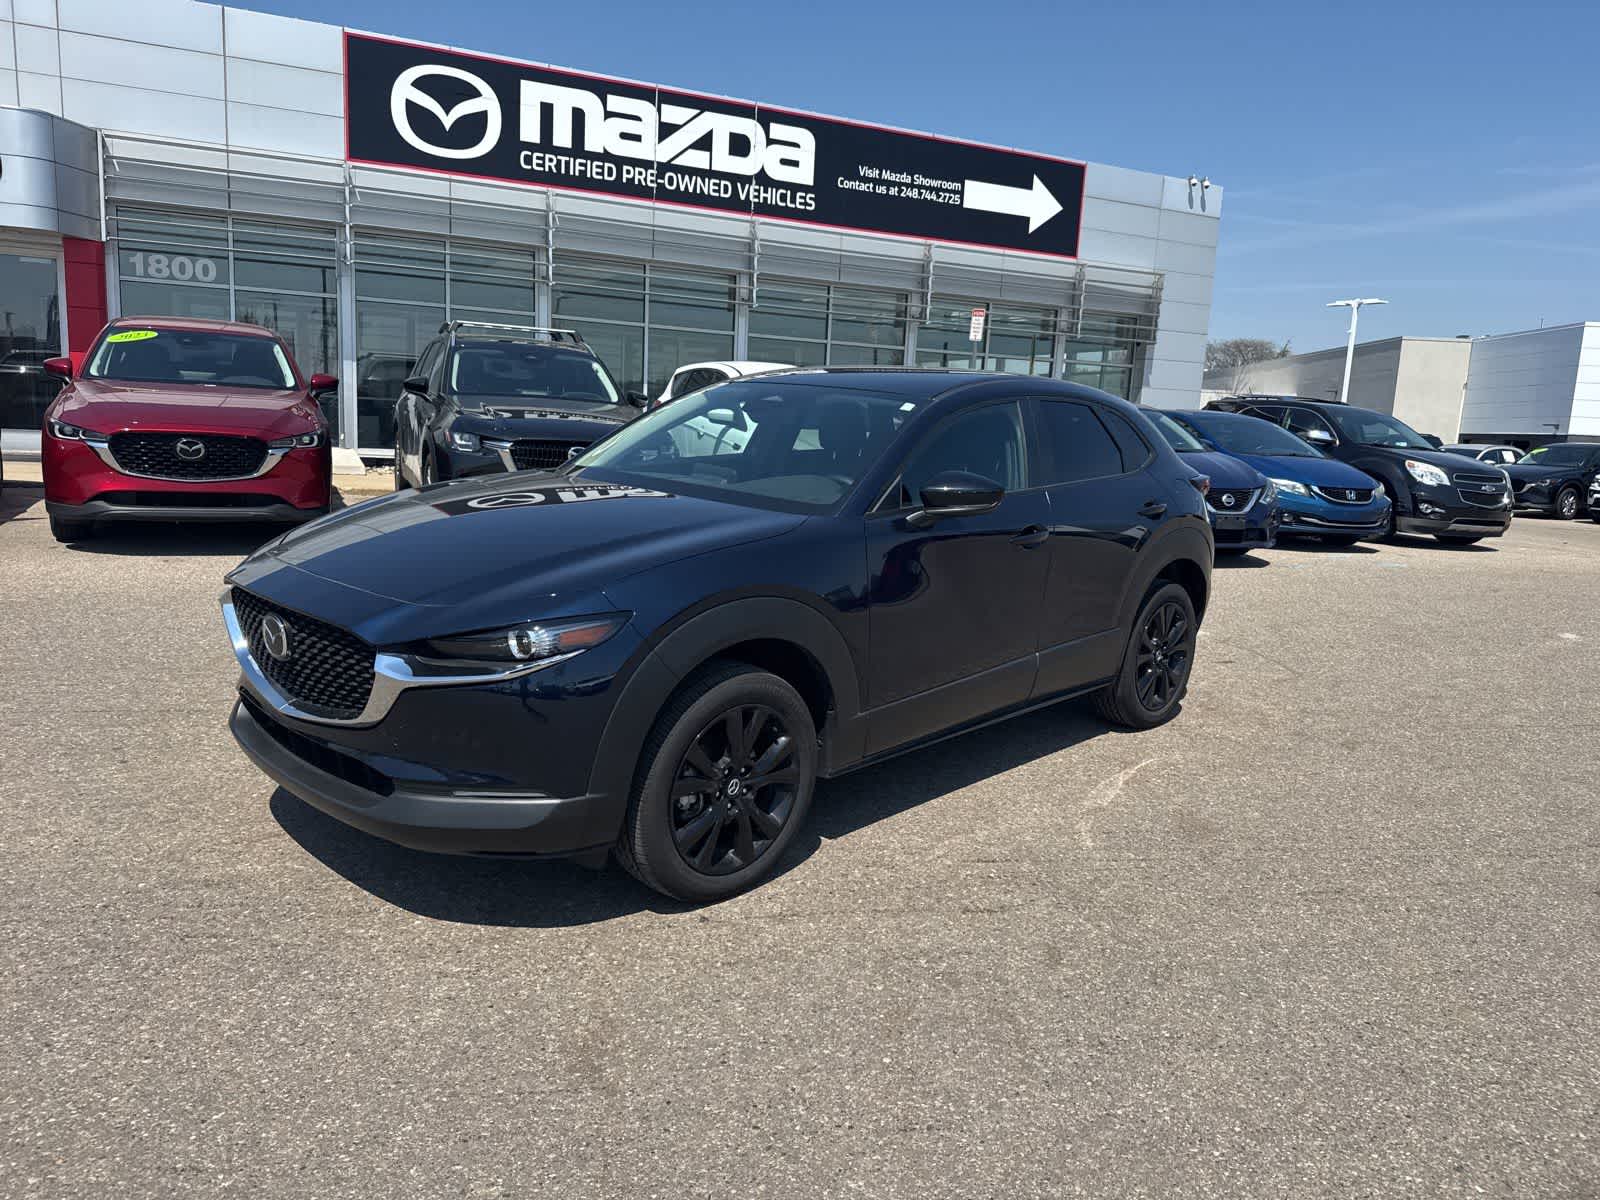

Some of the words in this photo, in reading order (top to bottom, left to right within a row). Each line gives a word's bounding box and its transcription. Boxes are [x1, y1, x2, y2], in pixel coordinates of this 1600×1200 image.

[520, 150, 617, 181] CERTIFIED
[622, 165, 732, 198] PRE-OWNED
[737, 182, 816, 211] VEHICLES
[837, 177, 874, 193] Contact
[875, 184, 887, 195] us
[889, 186, 899, 196] at
[900, 186, 961, 205] 248.744.2725
[859, 165, 880, 179] Visit
[881, 169, 912, 184] Mazda
[913, 174, 962, 191] Showroom
[129, 251, 217, 282] 1800
